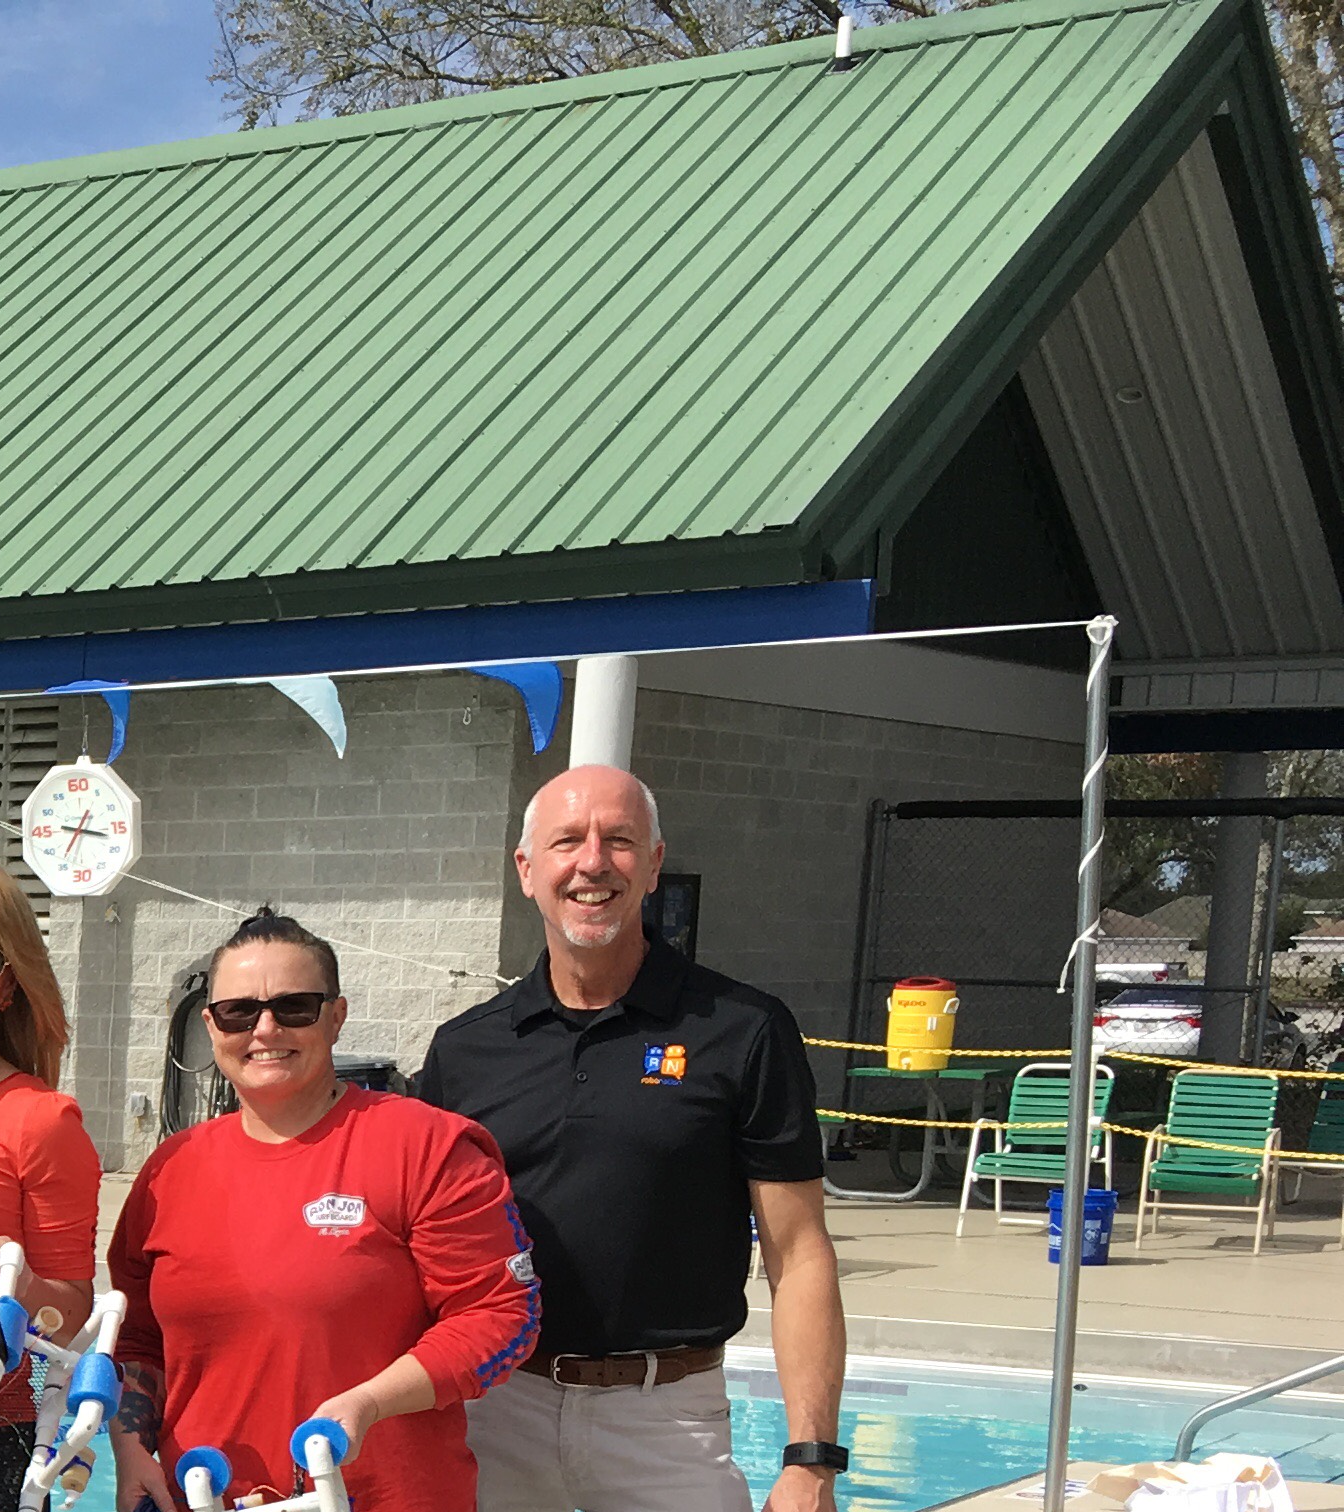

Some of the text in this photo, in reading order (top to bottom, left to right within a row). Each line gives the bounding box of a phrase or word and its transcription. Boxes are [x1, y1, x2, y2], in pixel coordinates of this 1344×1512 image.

[68, 778, 89, 792] 60
[53, 793, 65, 801] 55
[94, 788, 101, 797] 5
[106, 803, 116, 811] 10
[42, 808, 54, 817] 50
[31, 825, 53, 838] 45
[110, 821, 127, 834] 15
[109, 846, 120, 854] 20
[58, 863, 69, 871] 35
[96, 861, 107, 870] 25
[72, 869, 92, 882] 30
[666, 1059, 680, 1073] N
[309, 1198, 362, 1217] RON JON
